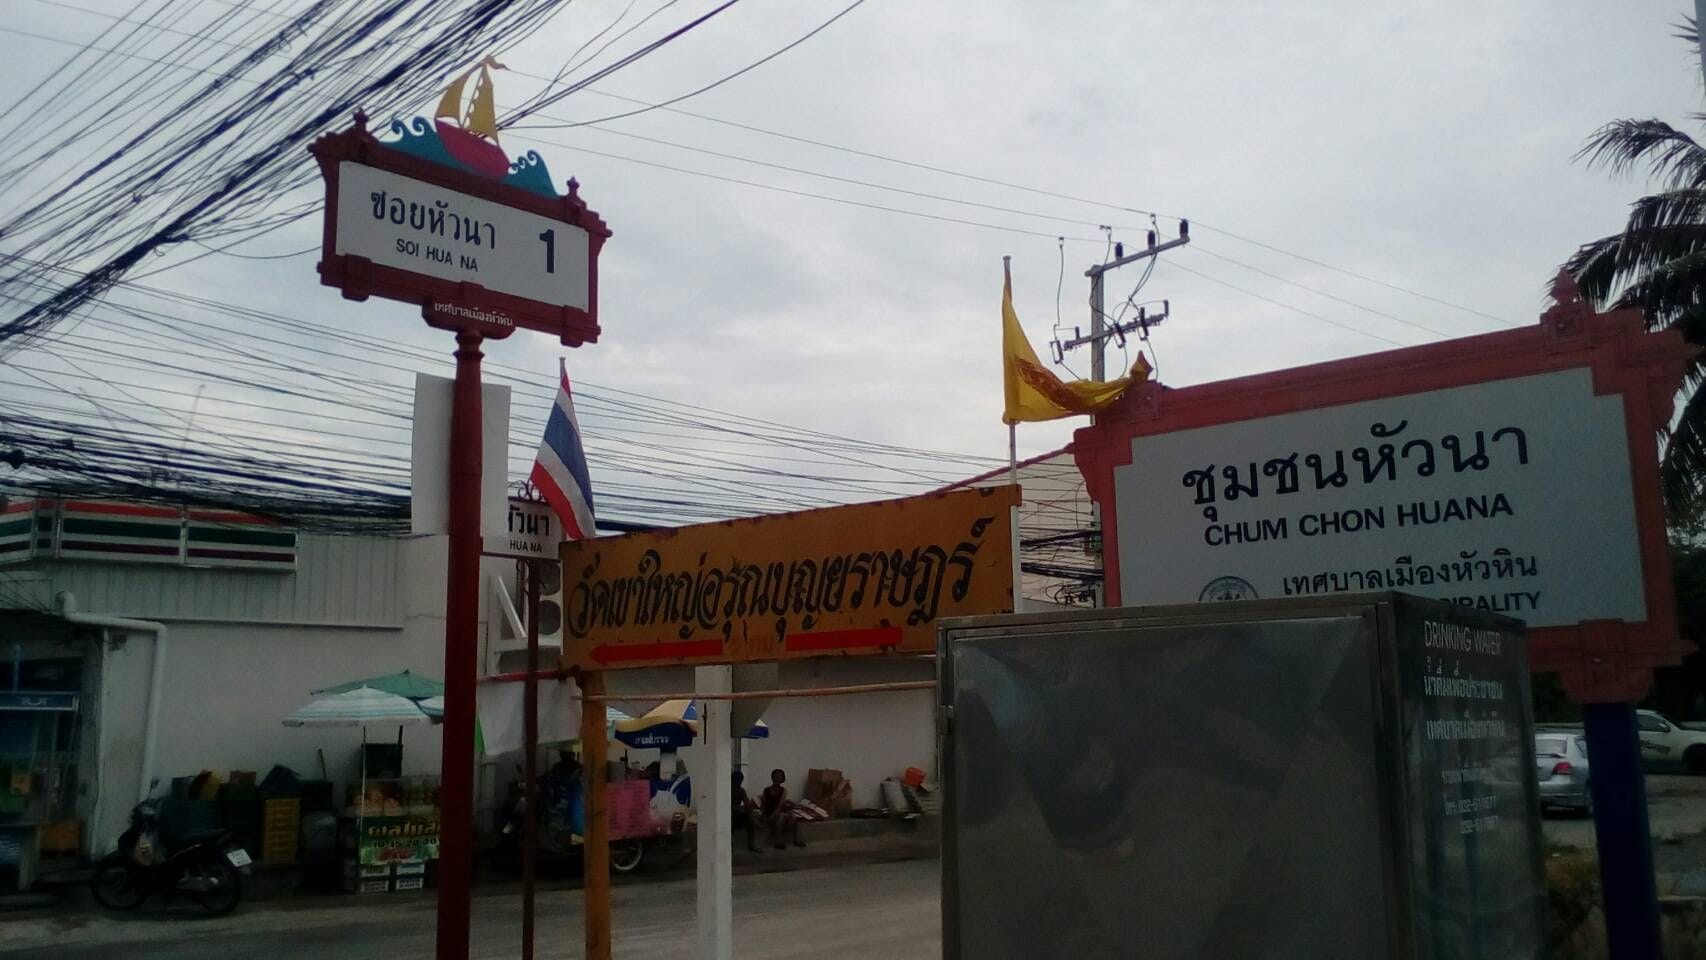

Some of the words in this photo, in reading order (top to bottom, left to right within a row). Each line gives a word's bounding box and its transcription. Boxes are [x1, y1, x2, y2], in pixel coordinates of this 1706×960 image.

[370, 191, 496, 250] ซอยหัวนา
[539, 229, 555, 274] 1
[395, 238, 419, 257] SOI
[426, 249, 453, 266] HUA
[460, 256, 478, 272] NA
[1182, 419, 1529, 523] ชุมชนหัวนา
[1204, 517, 1288, 547] CHUM
[1299, 507, 1385, 537] CHON
[1397, 492, 1514, 527] HUANA
[510, 540, 528, 551] HUA
[530, 542, 543, 553] NA
[1282, 548, 1539, 597] เทศบาลเมืองหัวหิน
[1424, 620, 1472, 652] DRINKING
[1473, 628, 1501, 657] WATER
